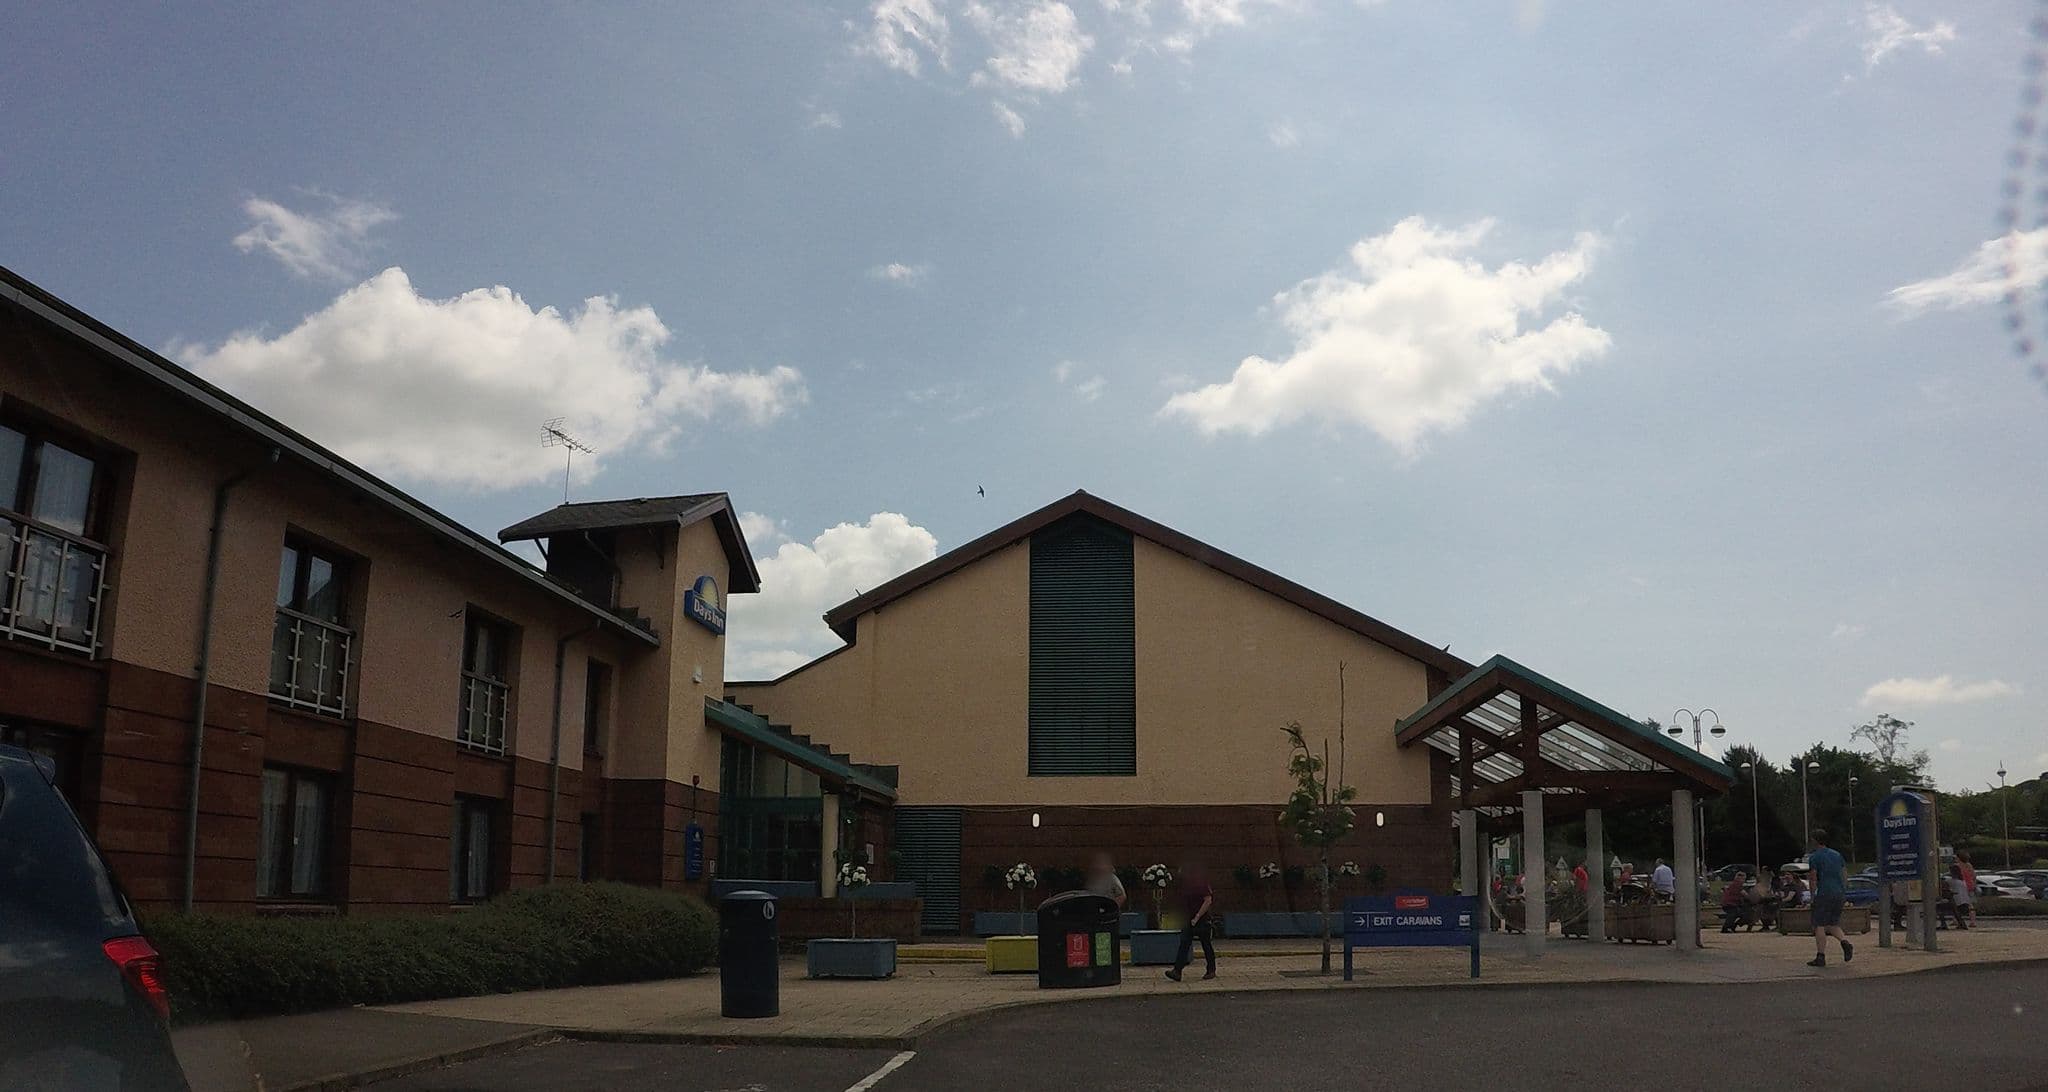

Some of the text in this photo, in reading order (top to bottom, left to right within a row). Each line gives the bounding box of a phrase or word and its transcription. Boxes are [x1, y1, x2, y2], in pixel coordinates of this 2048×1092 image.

[693, 598, 724, 630] Days Inn
[1883, 817, 1917, 828] Days Inn
[1373, 916, 1442, 926] EXIT CARAVANS
